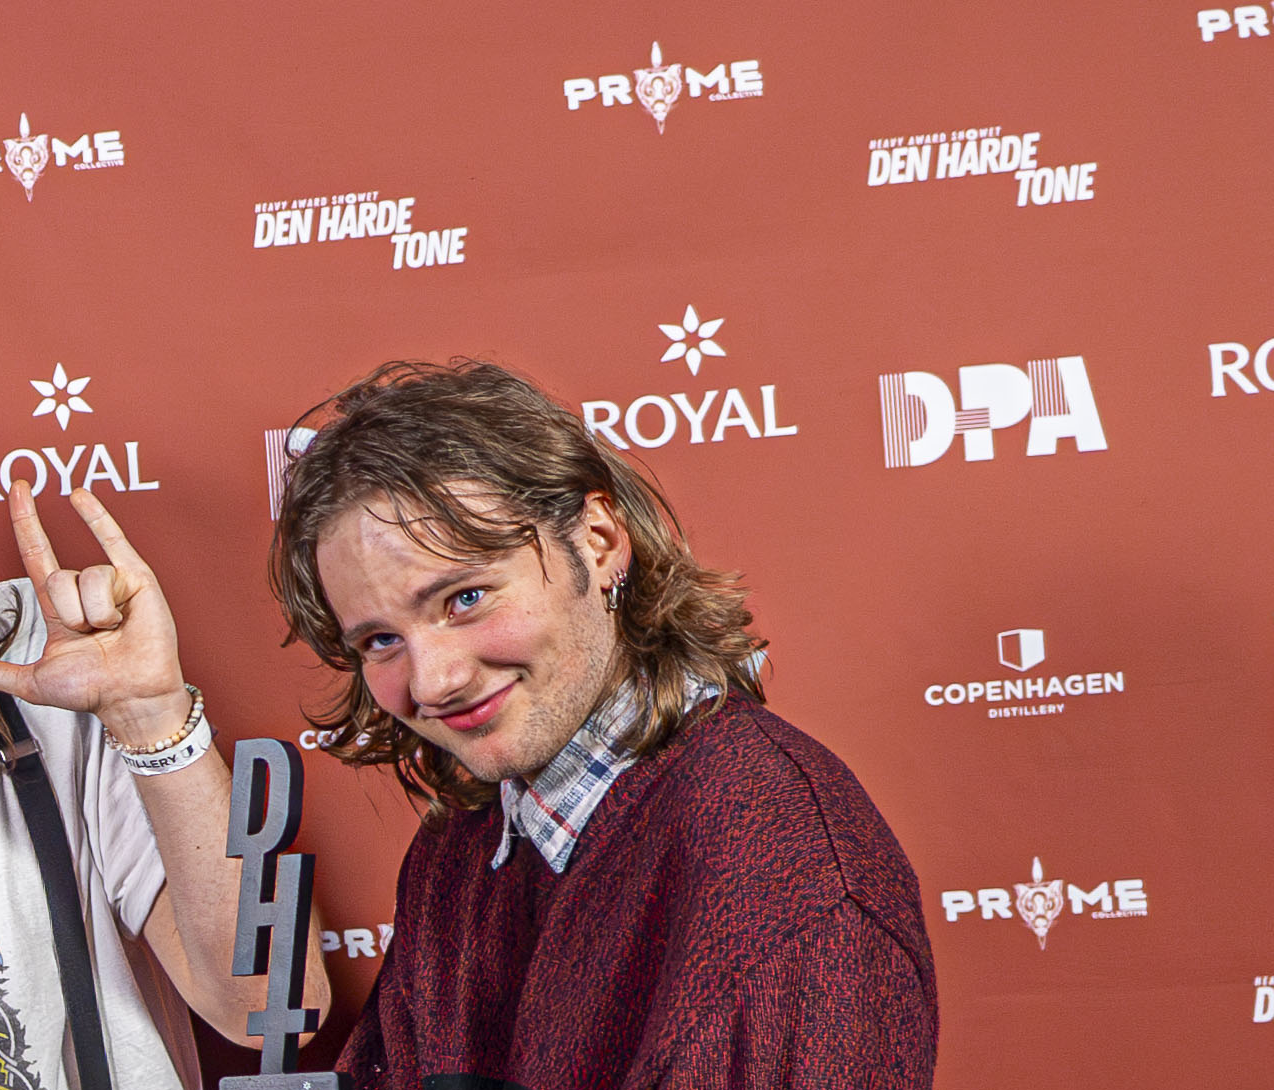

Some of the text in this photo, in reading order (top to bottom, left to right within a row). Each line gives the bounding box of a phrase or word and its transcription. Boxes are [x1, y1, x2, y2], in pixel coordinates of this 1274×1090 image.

[867, 145, 932, 187] DEN
[1014, 162, 1098, 208] TONE
[253, 208, 314, 249] DEN
[390, 227, 468, 271] TONE
[582, 384, 798, 450] ROYAL
[879, 355, 1108, 468] DPA
[924, 671, 1124, 706] COPENHAGEN
[988, 703, 1065, 719] DISTILLERY
